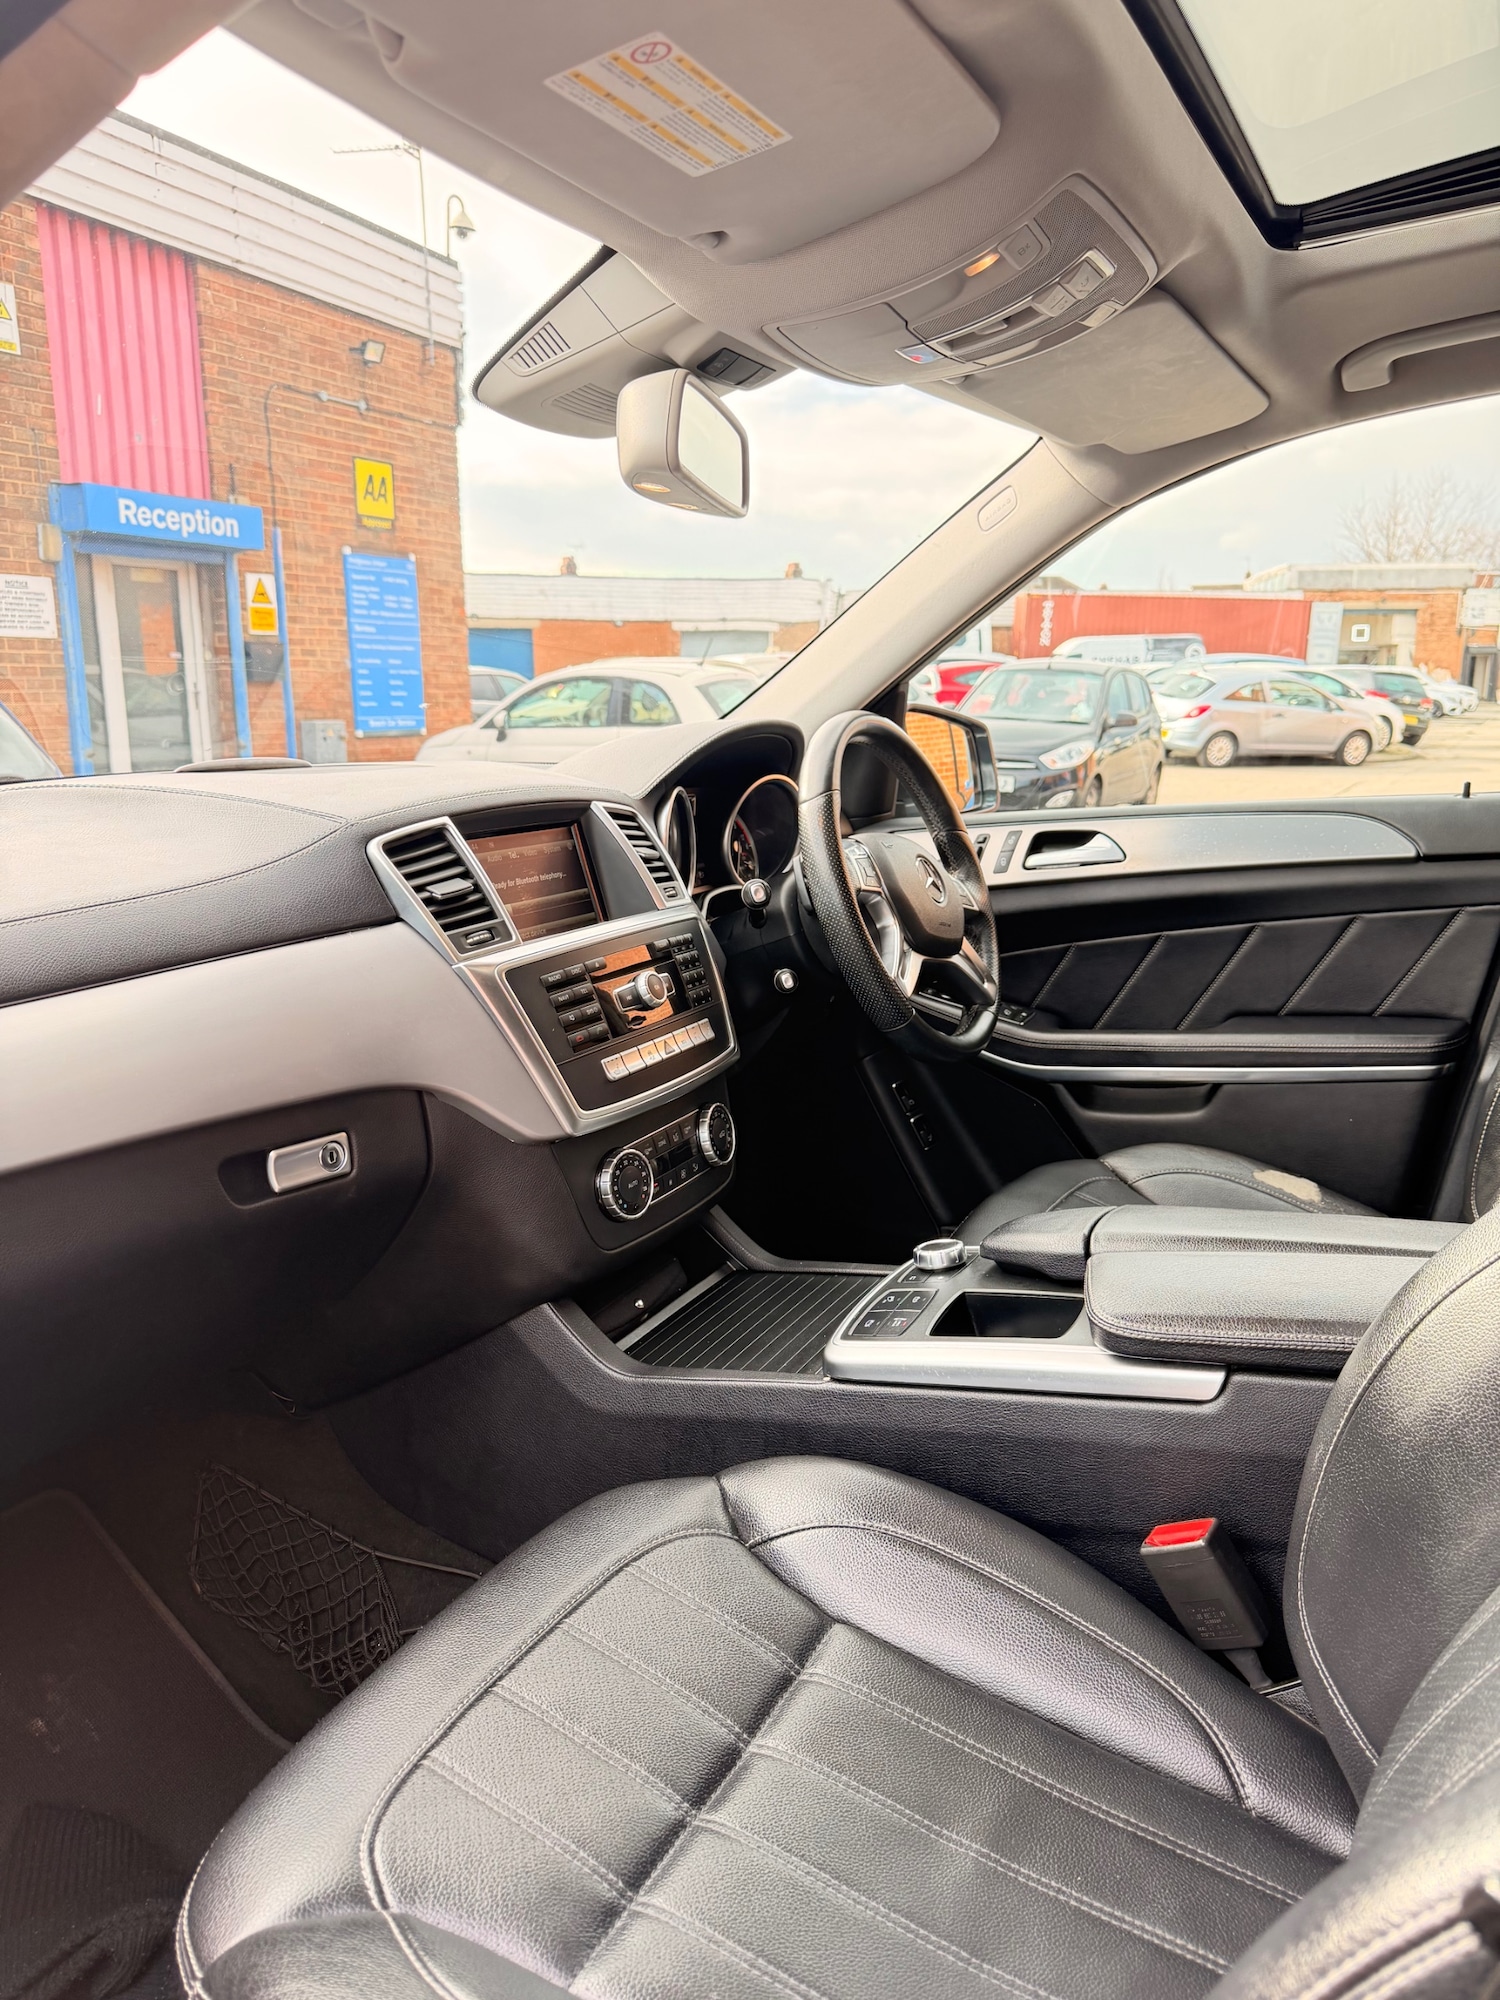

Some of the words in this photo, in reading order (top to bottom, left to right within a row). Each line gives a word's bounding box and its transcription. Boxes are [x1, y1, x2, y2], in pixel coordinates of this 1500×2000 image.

[363, 474, 388, 504] AA
[985, 497, 1012, 522] AIRBAG
[117, 497, 240, 539] Reception
[508, 850, 520, 859] Tel.
[543, 846, 562, 855] System
[487, 854, 503, 862] Audio
[507, 879, 515, 887] for
[515, 875, 540, 886] Bluetooth
[530, 928, 547, 937] device
[570, 967, 582, 975] DISC
[547, 974, 562, 982] RADIO
[628, 1180, 639, 1189] AUTO
